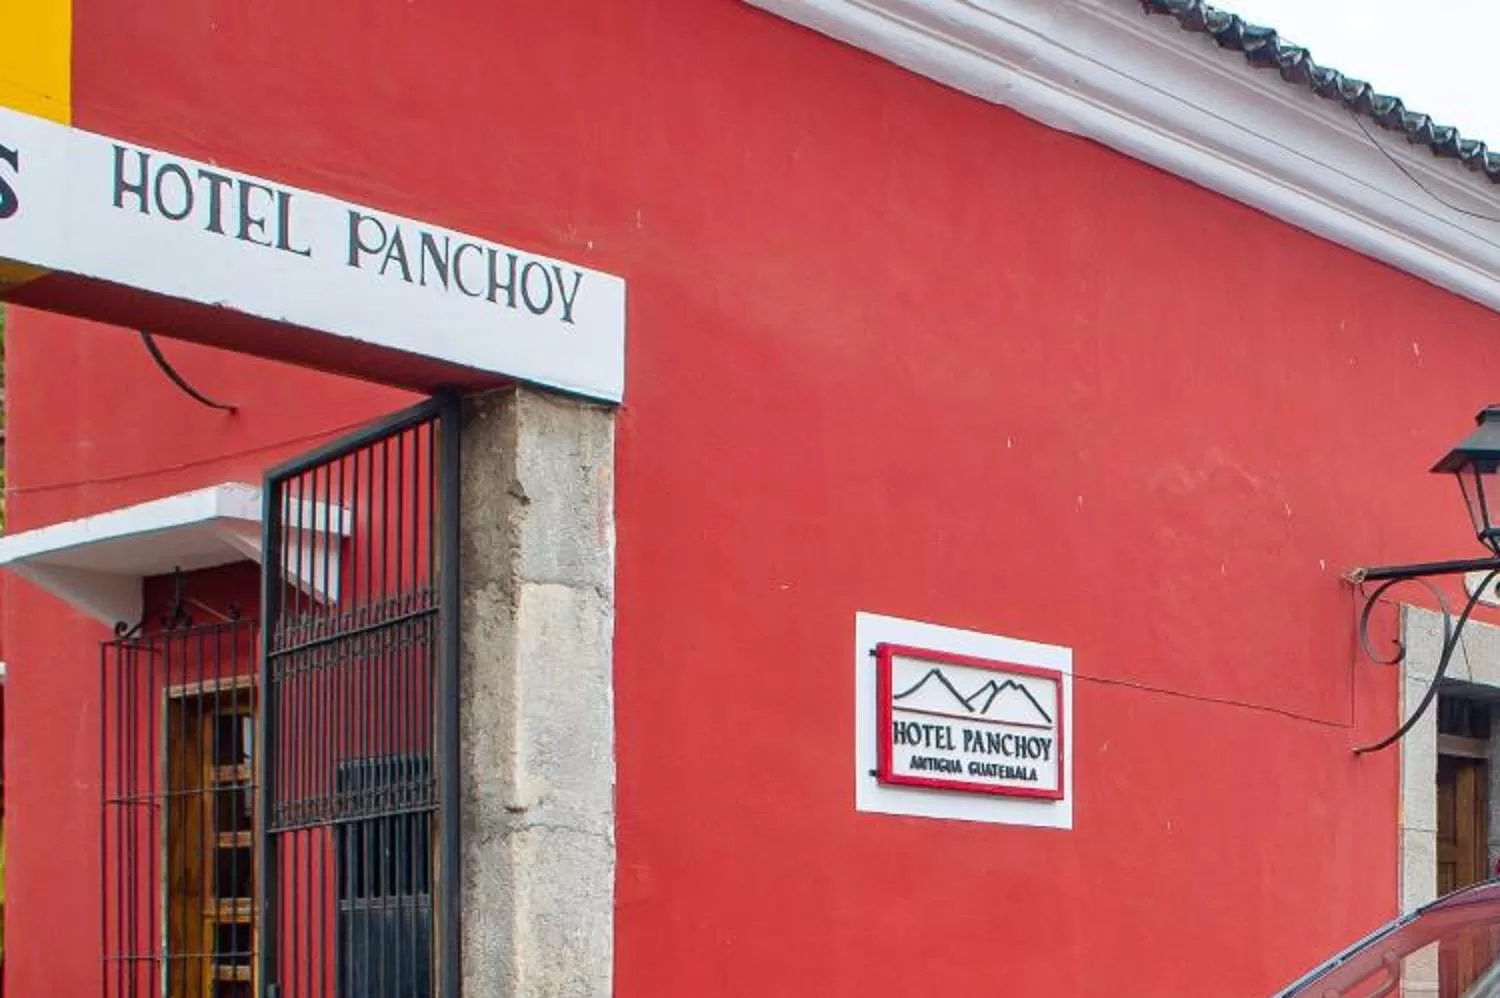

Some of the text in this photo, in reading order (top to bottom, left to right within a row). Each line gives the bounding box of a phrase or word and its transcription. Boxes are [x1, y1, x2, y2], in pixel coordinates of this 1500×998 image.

[112, 143, 583, 324] HOTEL PANCHOY
[893, 721, 1052, 761] HOTEL PANCHOY
[909, 755, 1038, 781] ANTIGUA GUATEMALA
